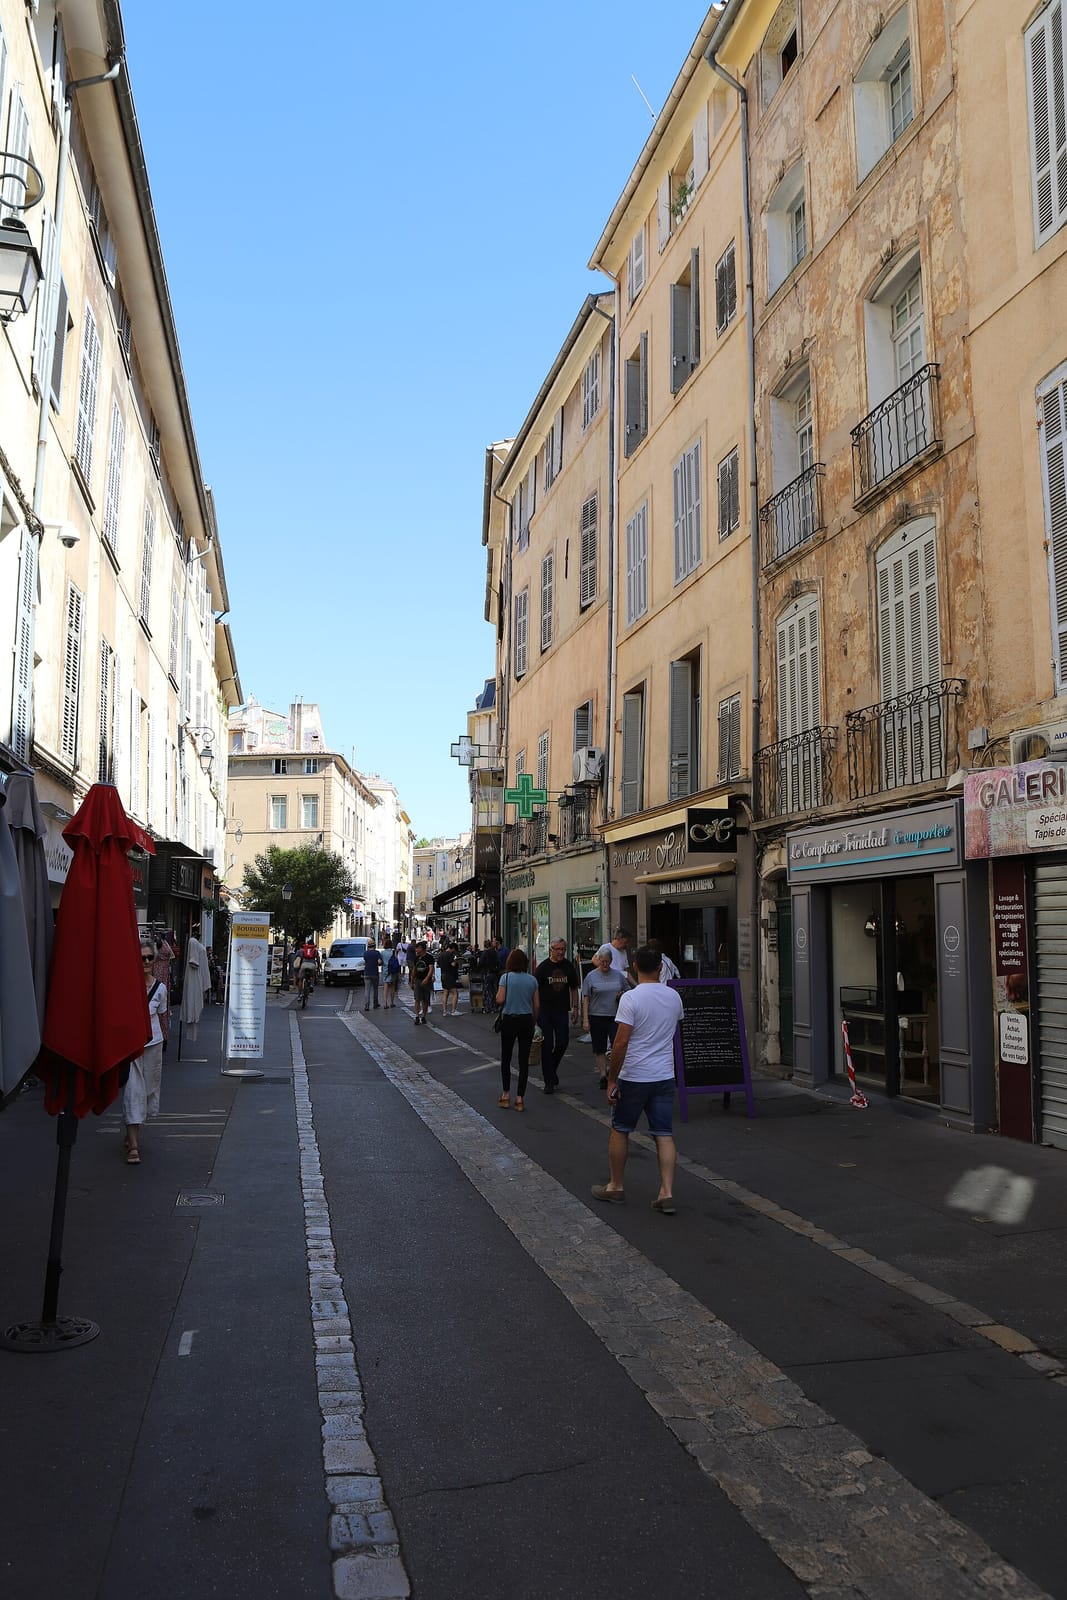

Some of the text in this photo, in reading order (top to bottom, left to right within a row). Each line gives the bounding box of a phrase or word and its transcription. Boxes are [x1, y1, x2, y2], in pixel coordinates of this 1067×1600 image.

[980, 768, 1065, 809] GALERI
[790, 842, 801, 860] Le
[802, 841, 841, 863] Comptoir
[841, 827, 887, 851] Trinidad
[903, 823, 951, 848] emporter
[1034, 826, 1067, 840] Tapis de
[613, 846, 650, 870] Boulangerie
